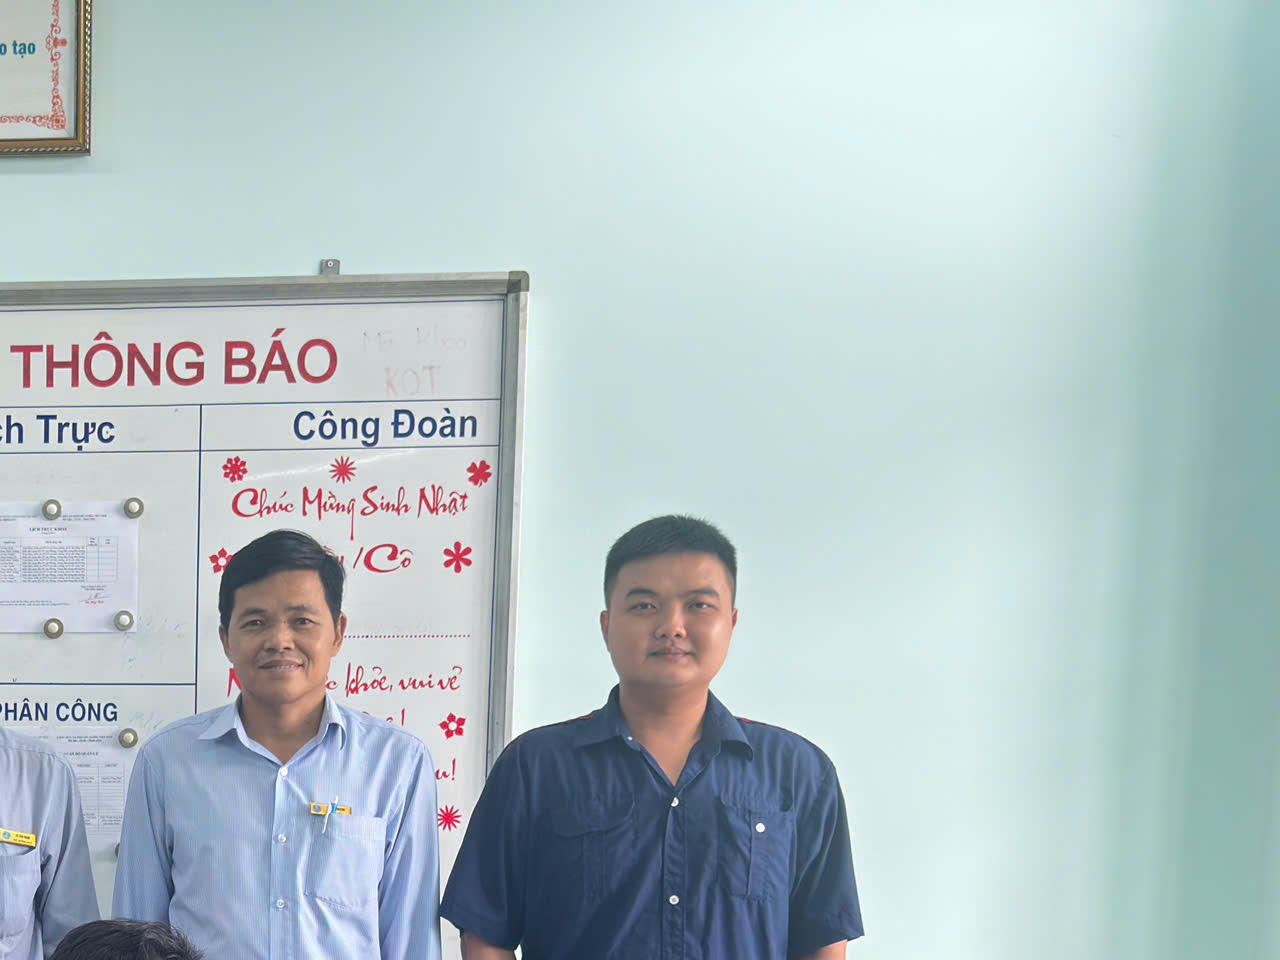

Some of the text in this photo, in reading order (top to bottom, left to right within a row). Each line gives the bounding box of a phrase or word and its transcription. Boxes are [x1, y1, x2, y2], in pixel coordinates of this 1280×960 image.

[12, 41, 36, 58] tạo
[10, 331, 205, 388] THÔNG
[224, 328, 338, 385] BÁO
[36, 414, 115, 452] Trực
[293, 408, 477, 447] Công Đoàn
[232, 484, 468, 541] Chúc Mừng Sinh Nhật
[56, 698, 118, 722] CÔNG
